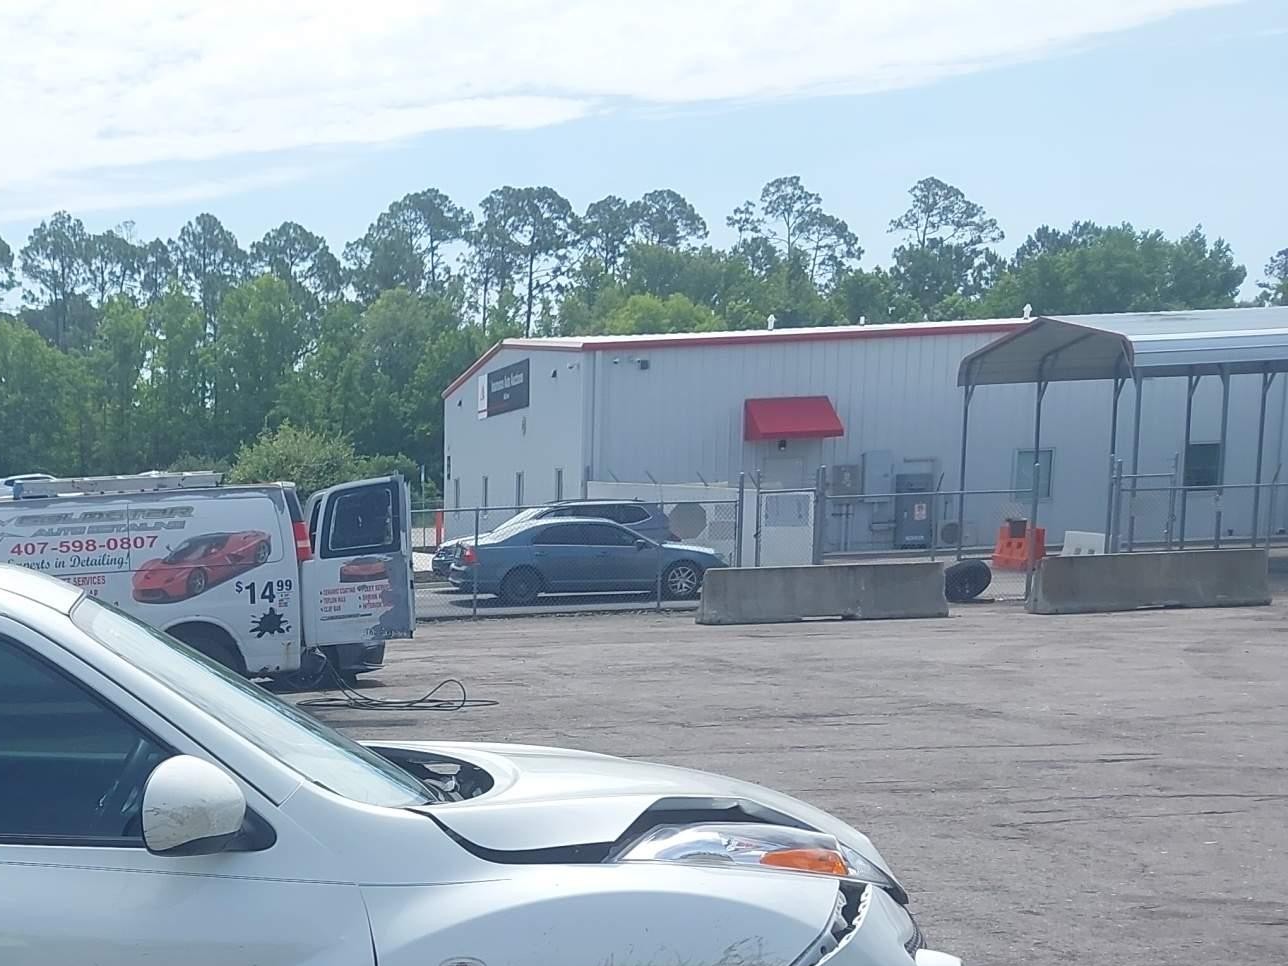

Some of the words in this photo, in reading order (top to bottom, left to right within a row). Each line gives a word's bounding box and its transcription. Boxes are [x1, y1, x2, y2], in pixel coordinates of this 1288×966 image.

[10, 535, 158, 556] 407-598-0807
[8, 558, 51, 570] perts
[54, 557, 65, 569] in
[69, 551, 130, 569] Detailing!
[73, 575, 106, 587] SERVICES
